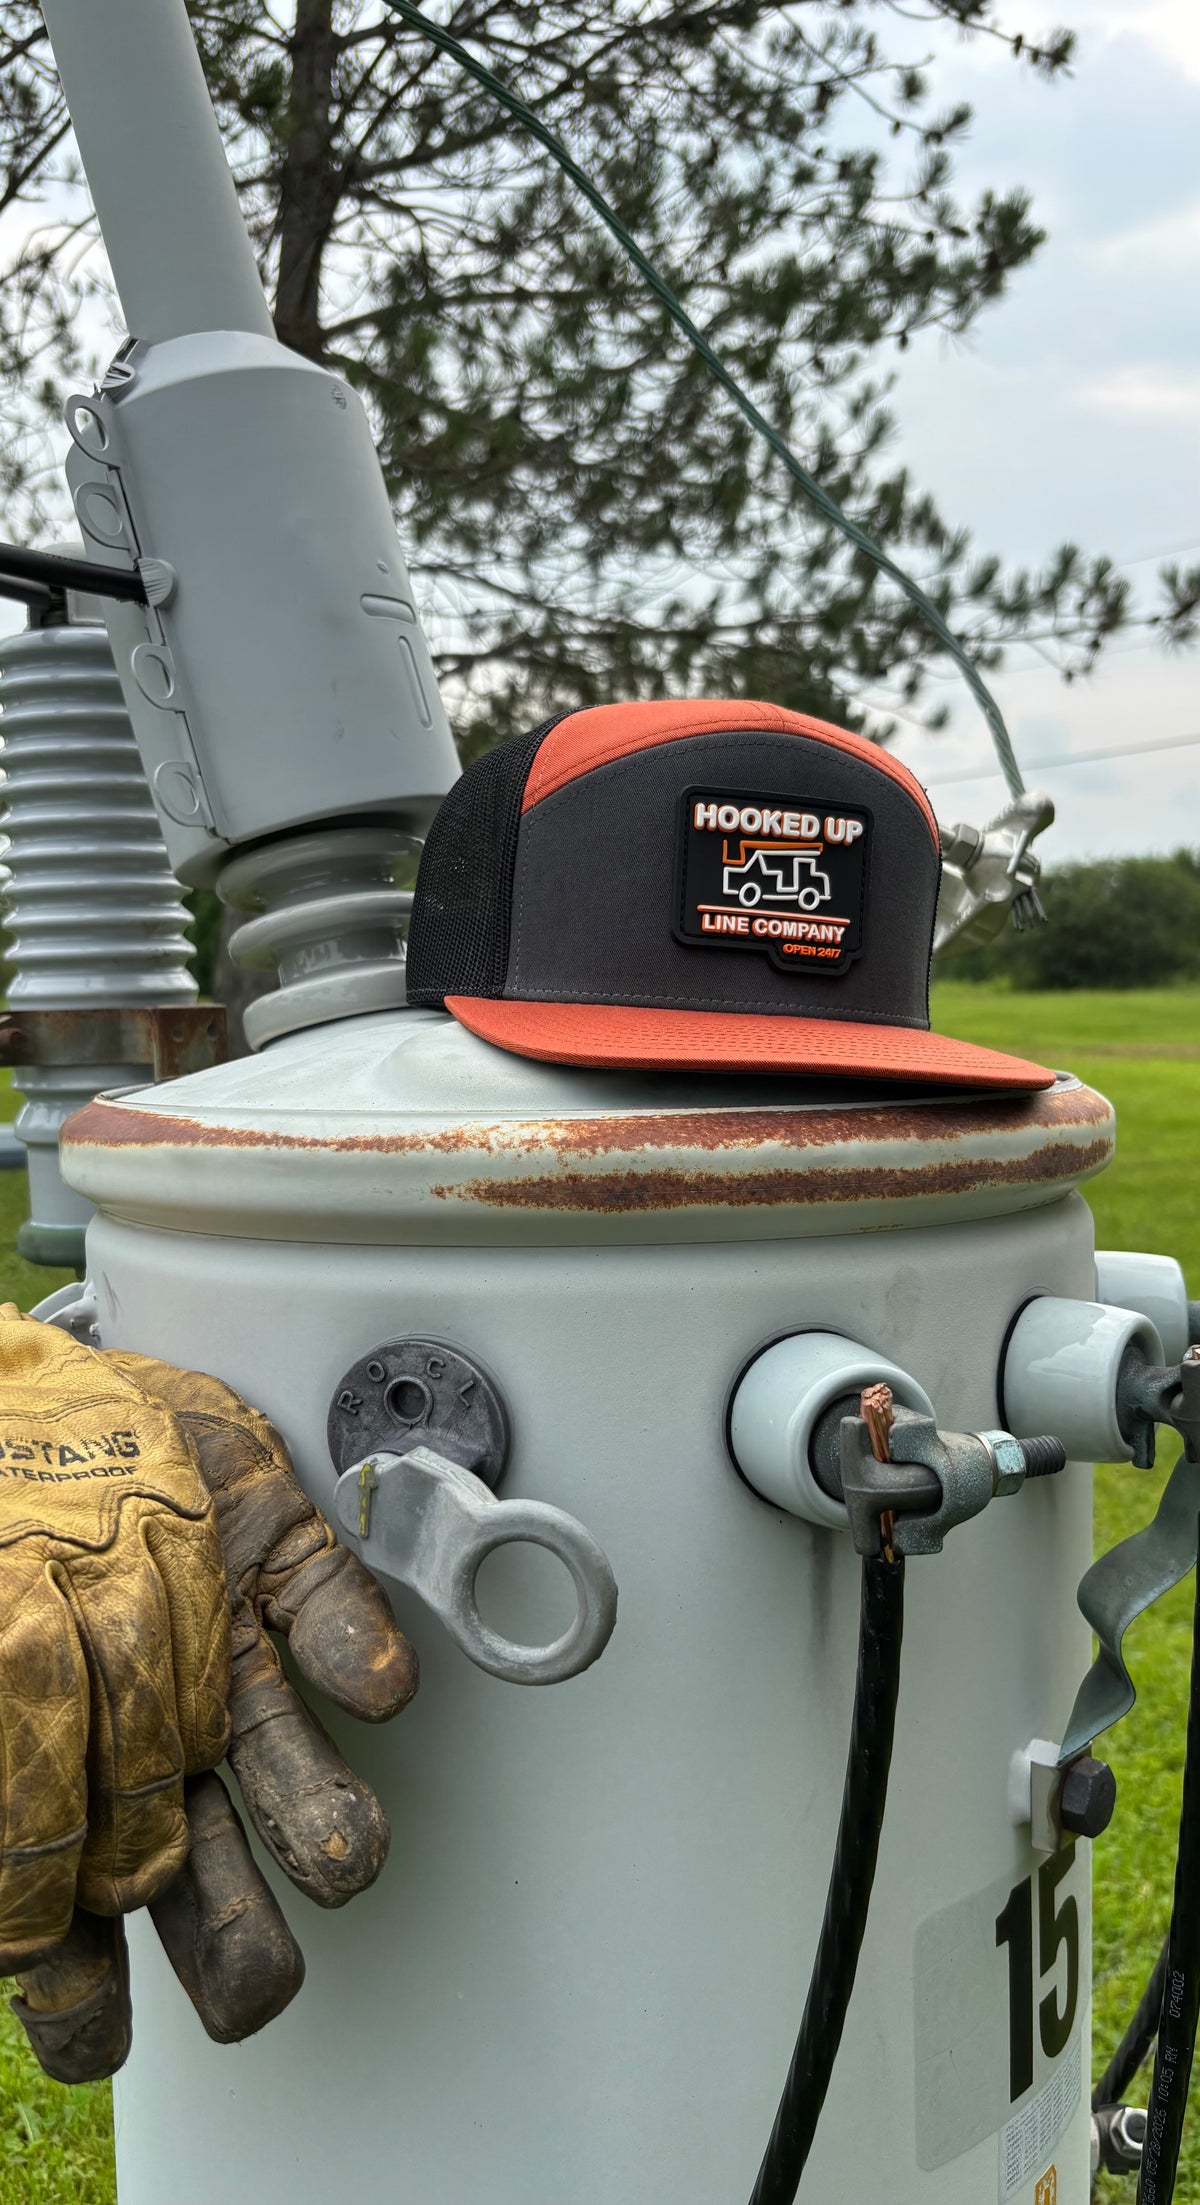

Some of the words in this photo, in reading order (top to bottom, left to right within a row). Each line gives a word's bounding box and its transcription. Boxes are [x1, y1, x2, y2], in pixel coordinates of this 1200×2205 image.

[694, 803, 820, 839] HOOKED
[824, 817, 863, 846] UP
[701, 913, 750, 935] LINE
[752, 917, 846, 944] COMPANY
[783, 943, 816, 957] OPEN
[817, 947, 842, 959] 24/7
[0, 1431, 141, 1467] STANG
[995, 1837, 1079, 2104] 15
